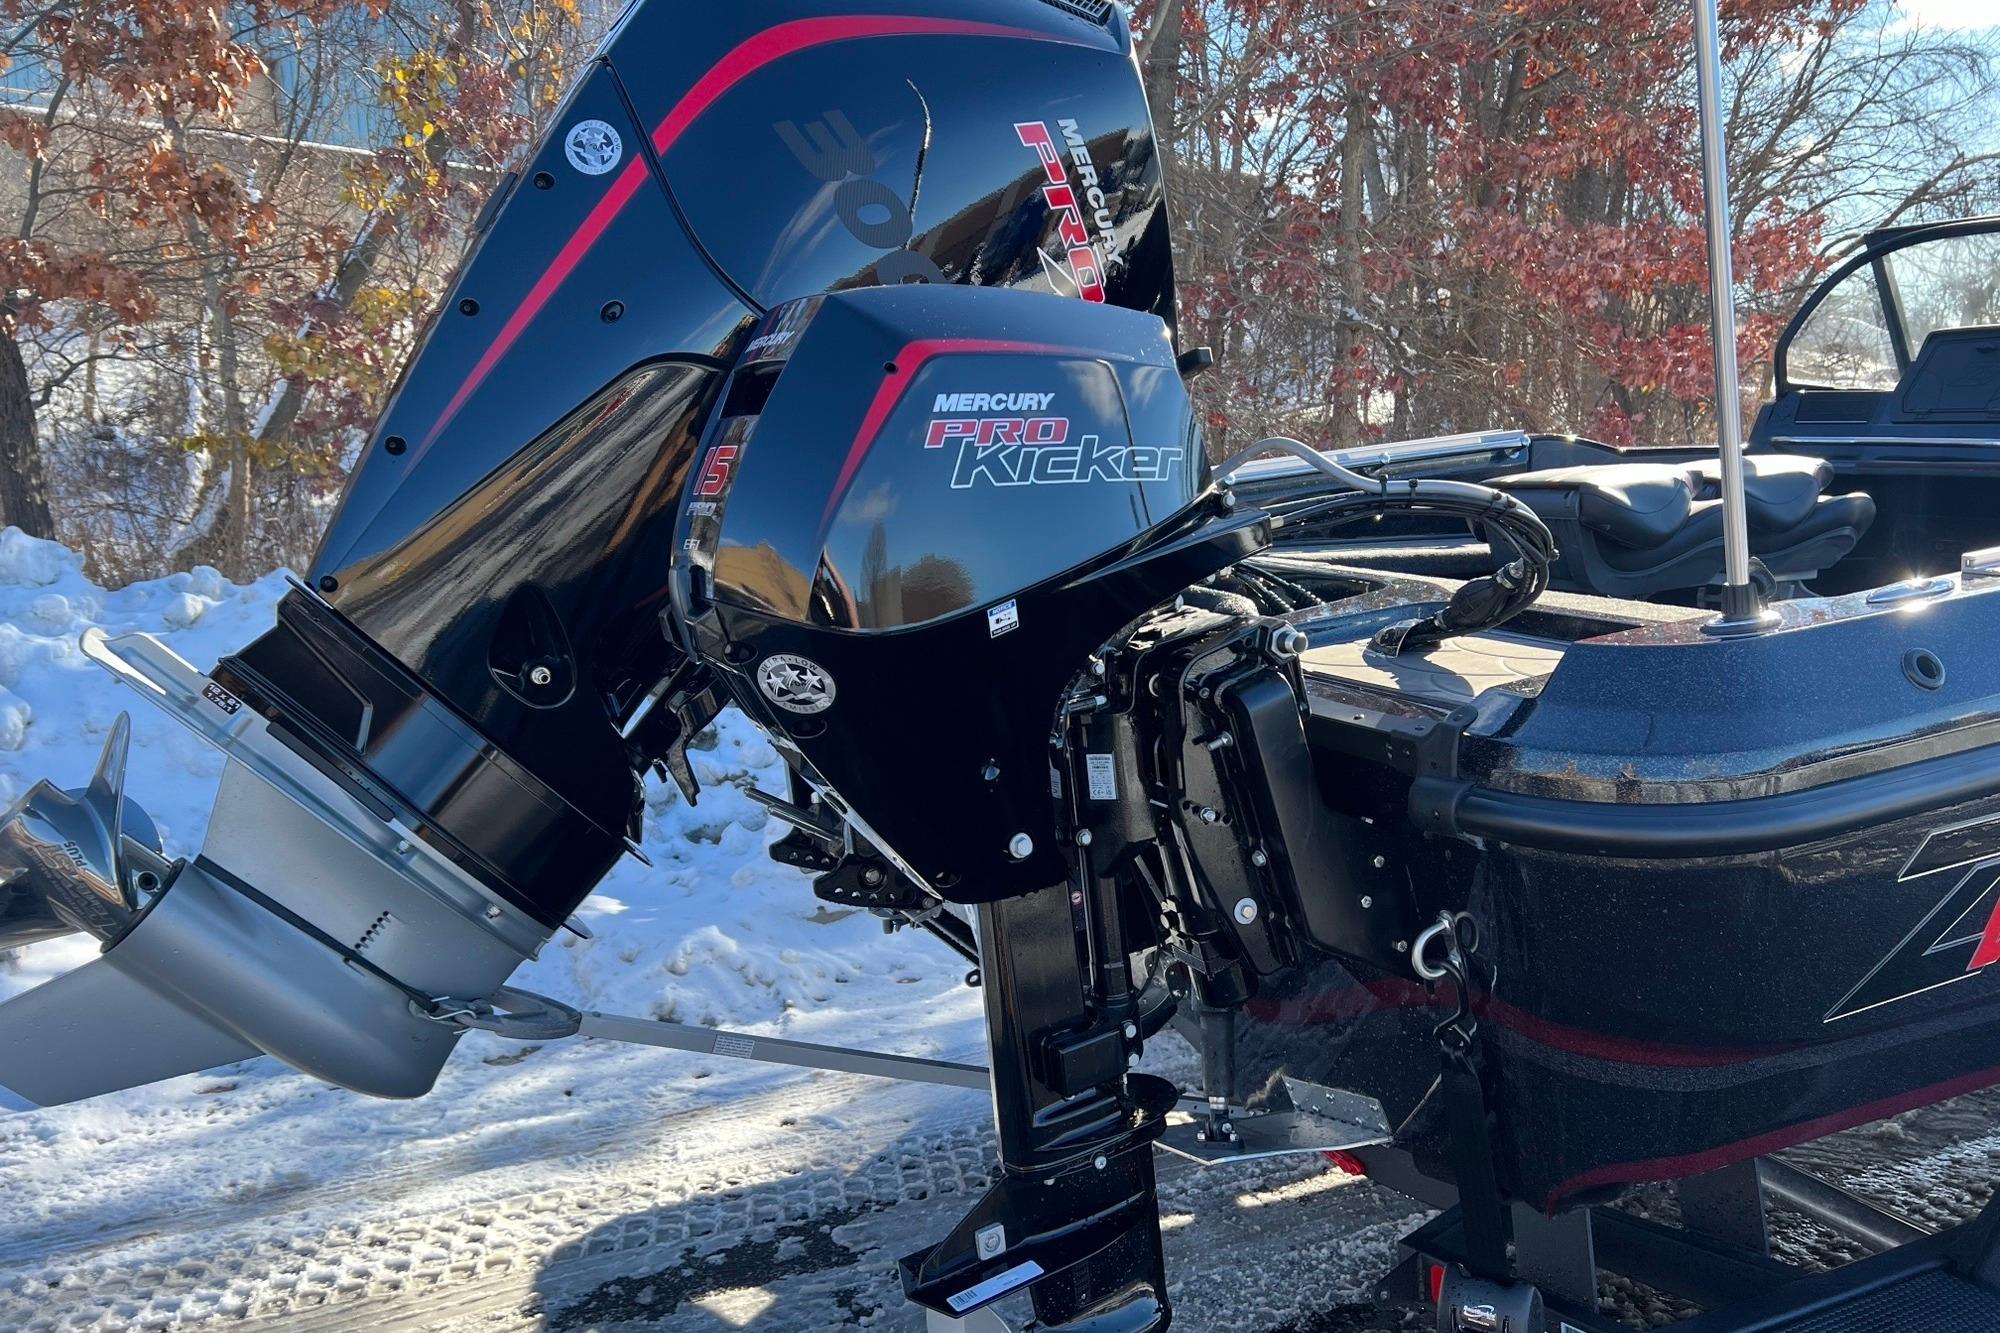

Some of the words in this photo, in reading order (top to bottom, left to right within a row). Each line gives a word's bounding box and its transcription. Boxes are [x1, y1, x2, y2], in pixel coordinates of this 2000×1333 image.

[1056, 118, 1124, 267] MERCURY
[1013, 120, 1106, 304] PRO
[932, 392, 1055, 413] MERCURY
[924, 417, 1069, 449] PRO
[692, 445, 739, 496] 15
[950, 434, 1184, 489] Kicker
[686, 501, 717, 517] PRO
[683, 538, 701, 550] EFI
[760, 656, 787, 673] ULTRA
[794, 657, 818, 671] LOW
[64, 841, 88, 868] PLUS
